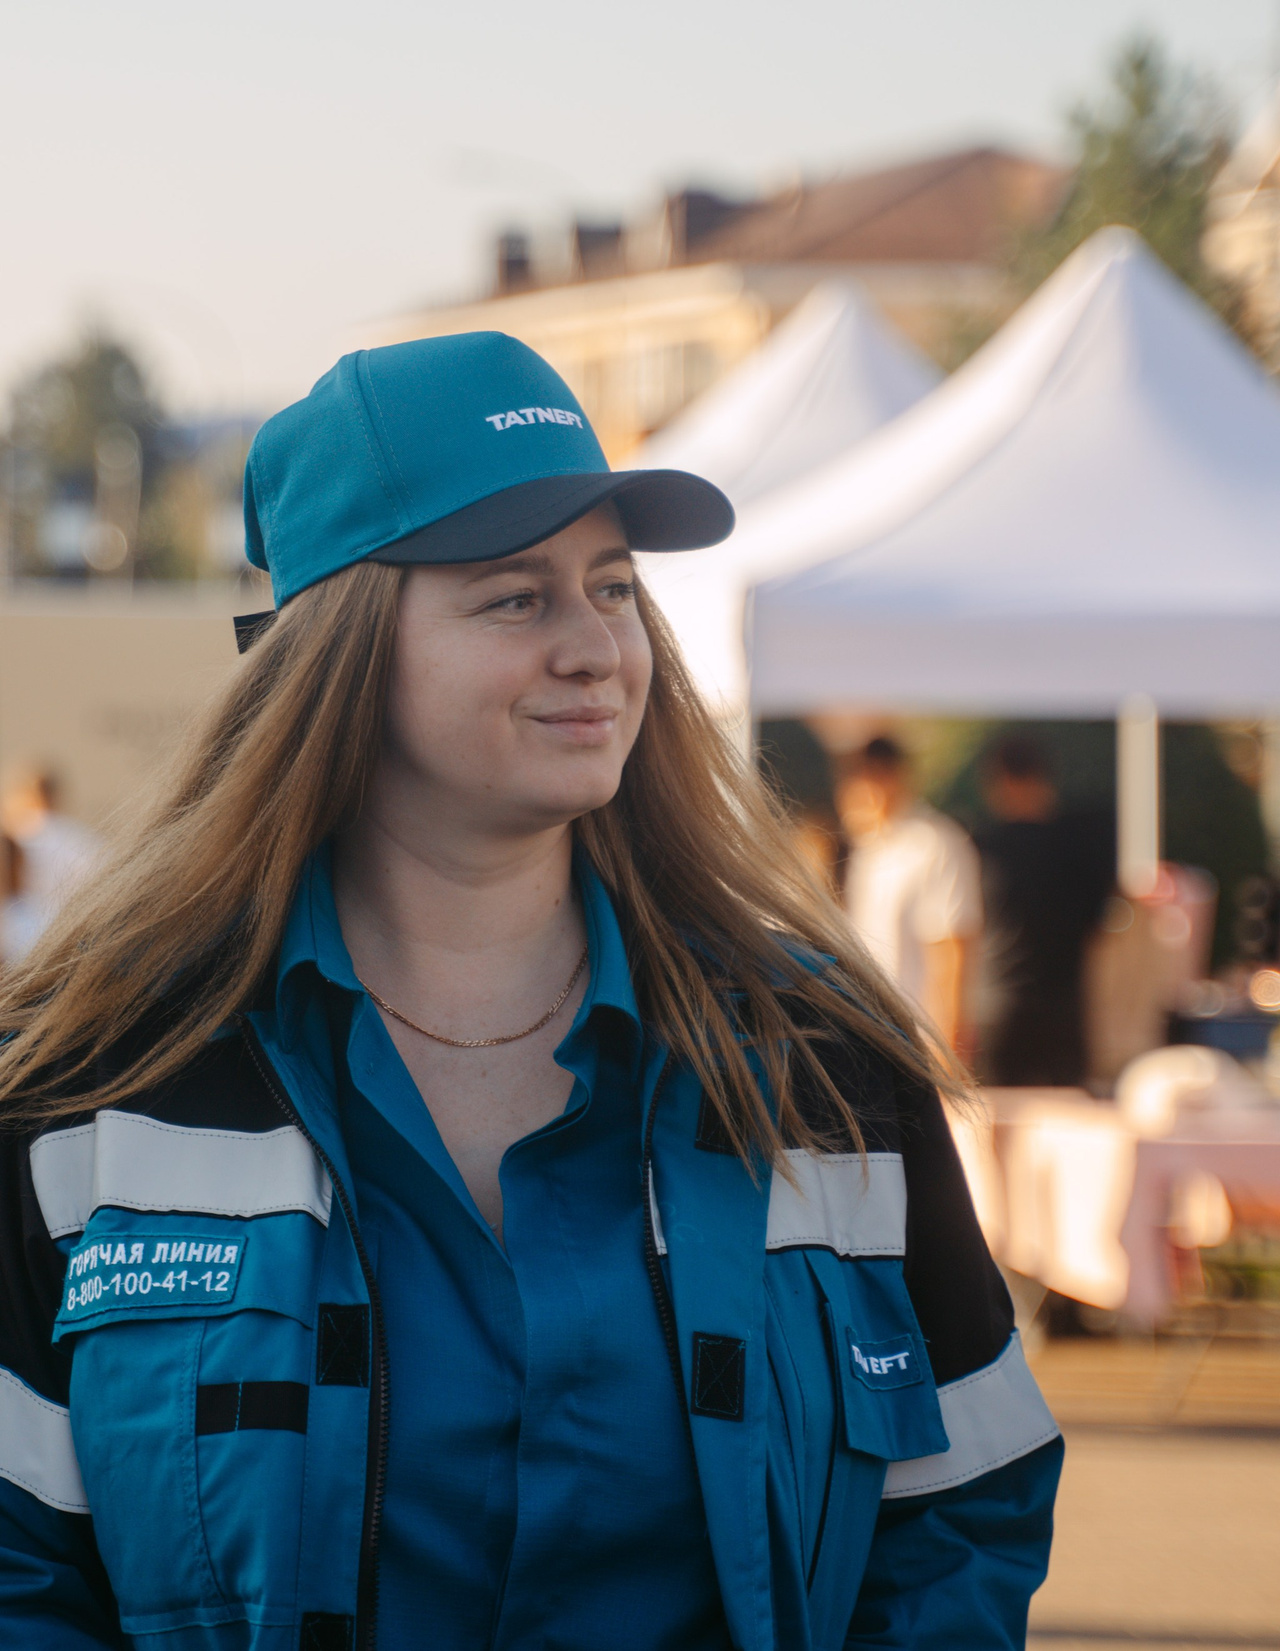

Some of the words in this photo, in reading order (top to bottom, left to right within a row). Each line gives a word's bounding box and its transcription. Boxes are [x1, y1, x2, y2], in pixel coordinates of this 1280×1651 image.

[485, 407, 584, 431] TATNEFT
[69, 1243, 144, 1279] ГОРЯЧАЯ
[152, 1242, 238, 1264] ЛИНИЯ
[67, 1270, 231, 1311] 8-800-100-41-12
